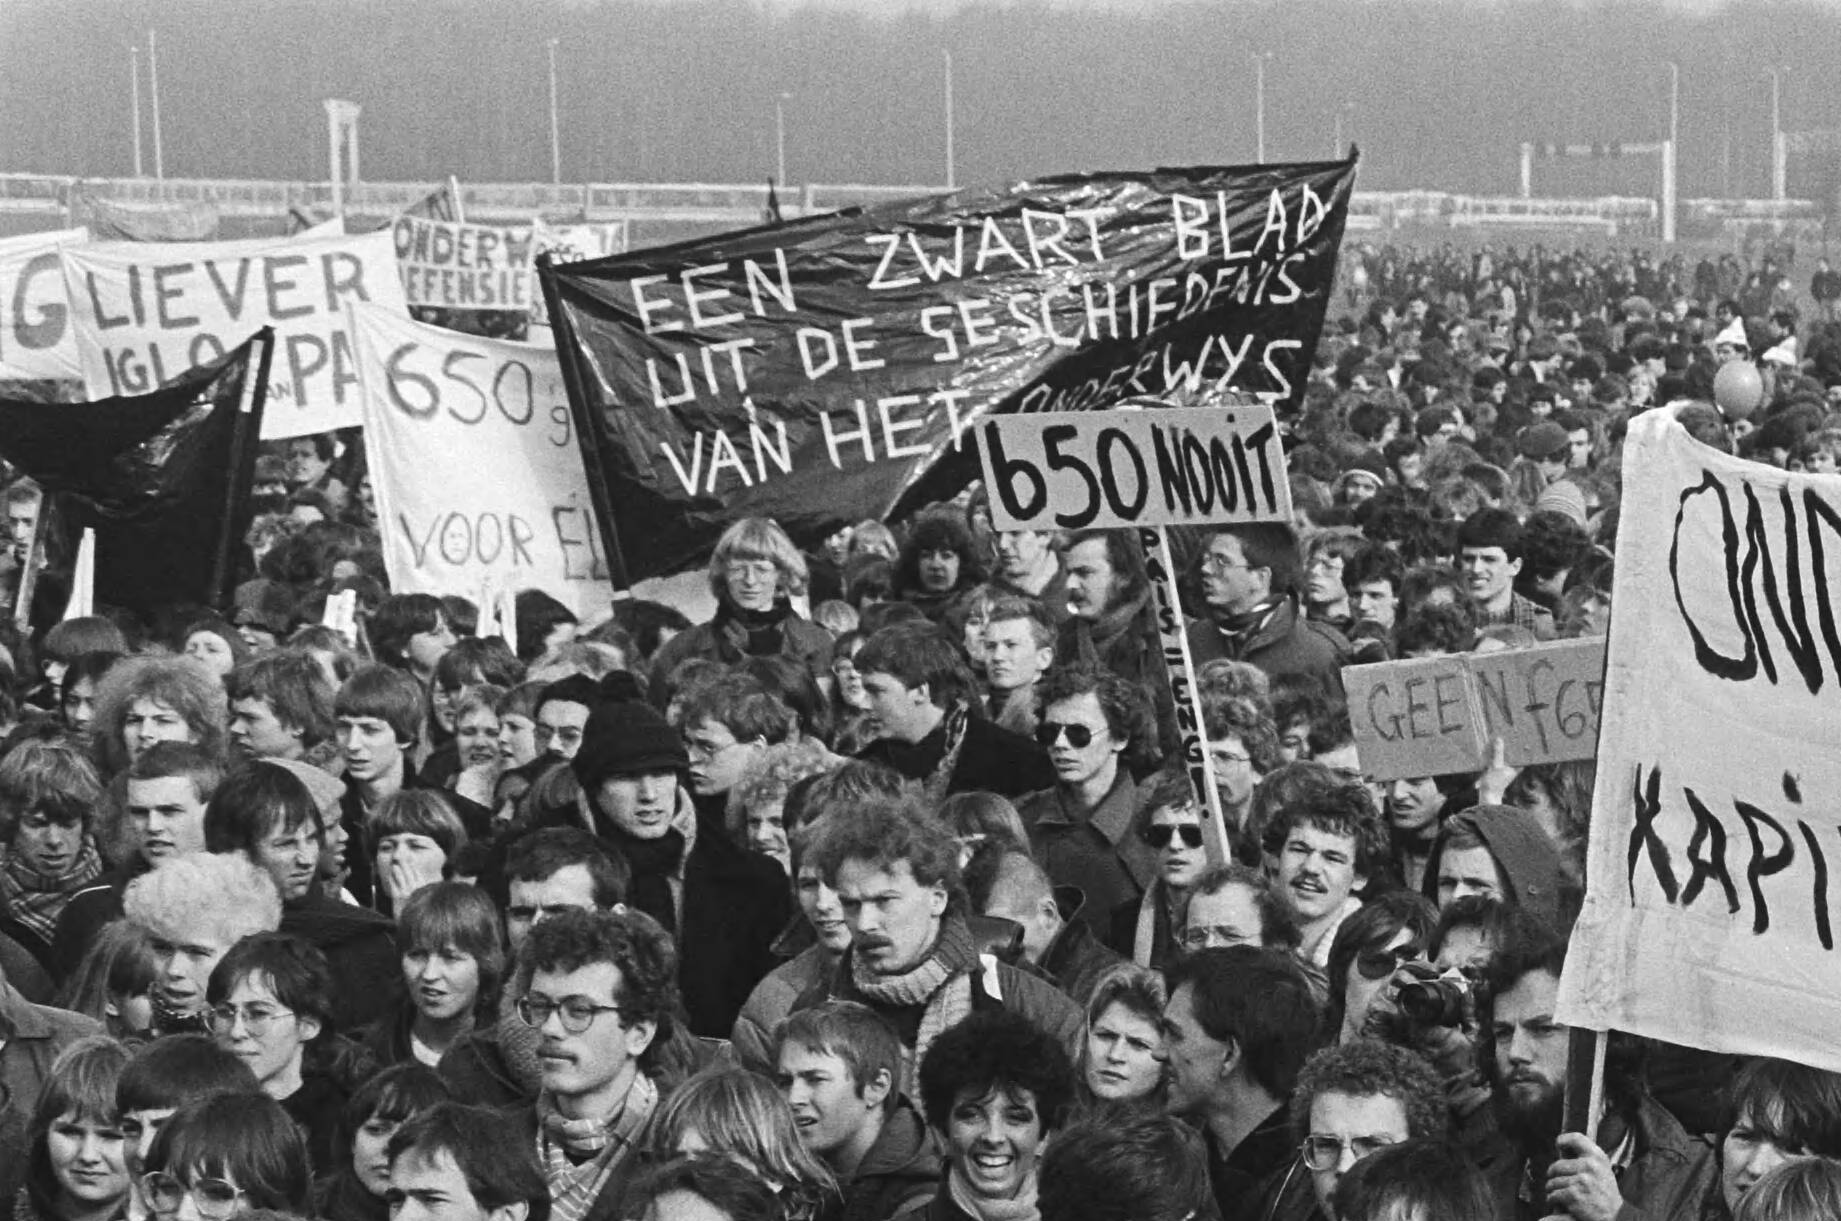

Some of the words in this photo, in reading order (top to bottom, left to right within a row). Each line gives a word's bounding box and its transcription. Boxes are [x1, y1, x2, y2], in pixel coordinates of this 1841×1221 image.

[86, 251, 371, 329] LIEVER
[400, 267, 528, 304] EFENSIE
[630, 248, 797, 334] EEN
[865, 207, 1116, 290] ZWART
[1173, 183, 1325, 260] BLAD
[386, 342, 533, 426] 650
[646, 338, 755, 409] UIT
[797, 318, 886, 381] DE
[661, 421, 792, 496] VAN
[820, 389, 972, 469] HET
[983, 417, 1149, 529] 650
[399, 511, 534, 568] VOOR
[1367, 668, 1514, 742] GEEN
